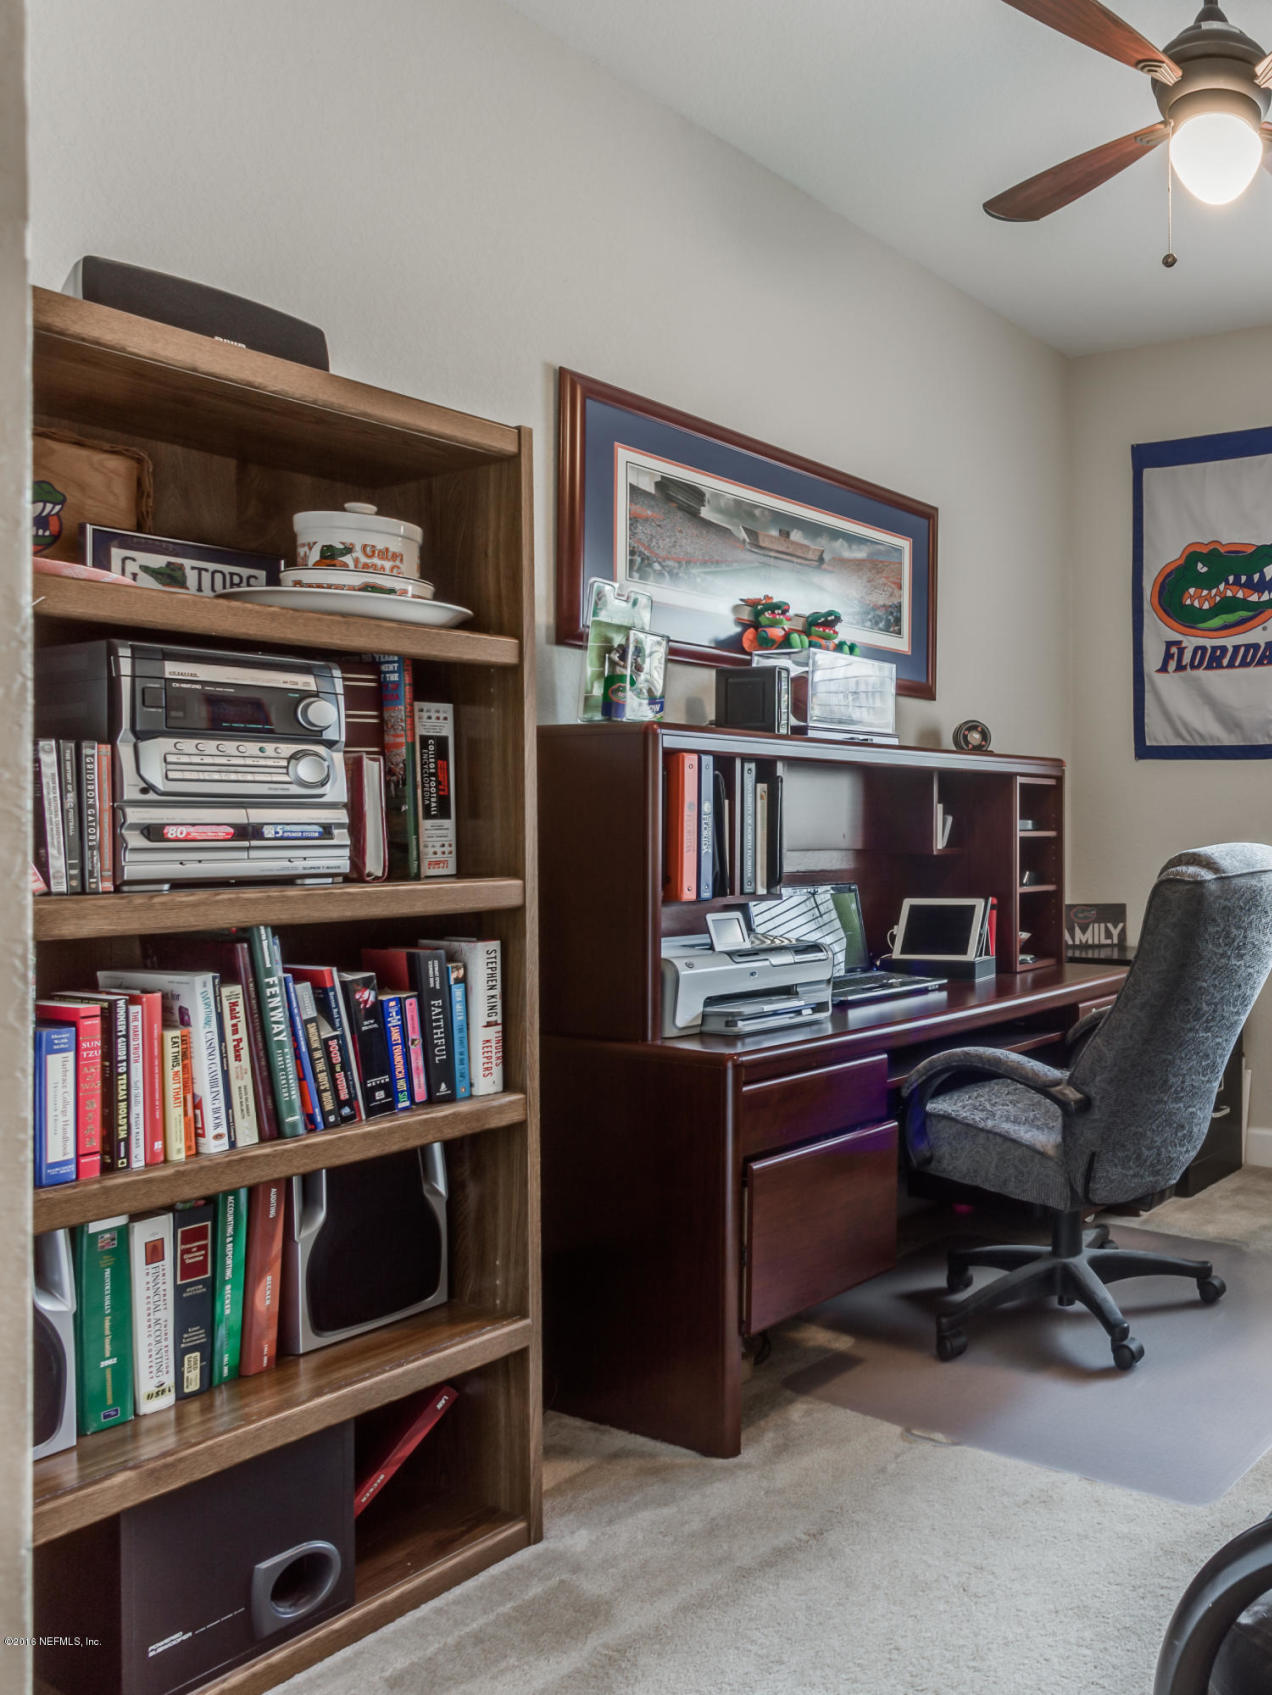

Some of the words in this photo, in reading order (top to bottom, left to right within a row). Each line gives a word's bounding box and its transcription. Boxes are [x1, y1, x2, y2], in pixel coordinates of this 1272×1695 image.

[428, 739, 436, 773] COLLEGE
[86, 757, 96, 804] GRIDIRON
[437, 759, 448, 795] ESPN
[88, 809, 97, 846] GATORS
[1065, 923, 1124, 945] MILY
[486, 949, 497, 992] STEPHEN
[116, 999, 126, 1036] WINNER'S
[131, 1011, 139, 1022] THE
[264, 976, 287, 1041] FENWAY
[486, 995, 498, 1017] KING
[81, 1040, 101, 1049] SUN
[171, 1036, 179, 1050] EAT
[205, 1031, 216, 1061] CASINO
[431, 1000, 447, 1063] FAITHFUL
[82, 1050, 101, 1058] TZU
[117, 1037, 127, 1060] GUIDE
[171, 1052, 181, 1070] THIS,
[232, 1037, 243, 1062] Poker
[482, 1039, 493, 1078] KEEPERS
[494, 1031, 503, 1067] FINDERS
[118, 1062, 127, 1072] TO
[172, 1071, 181, 1086] NOT
[117, 1074, 127, 1099] TEXAS
[173, 1087, 182, 1108] THAT!
[207, 1063, 220, 1106] GAMBLING
[279, 1071, 289, 1101] CENTURY
[61, 1091, 70, 1117] College
[213, 1108, 224, 1131] BOOK
[62, 1120, 70, 1157] Handbook
[226, 1196, 234, 1236] ACCOUNTING
[269, 1187, 277, 1218] AUDITING
[225, 1244, 233, 1280] REPORTING
[151, 1265, 163, 1315] FINANCIAL
[153, 1318, 165, 1378] ACCOUNTING
